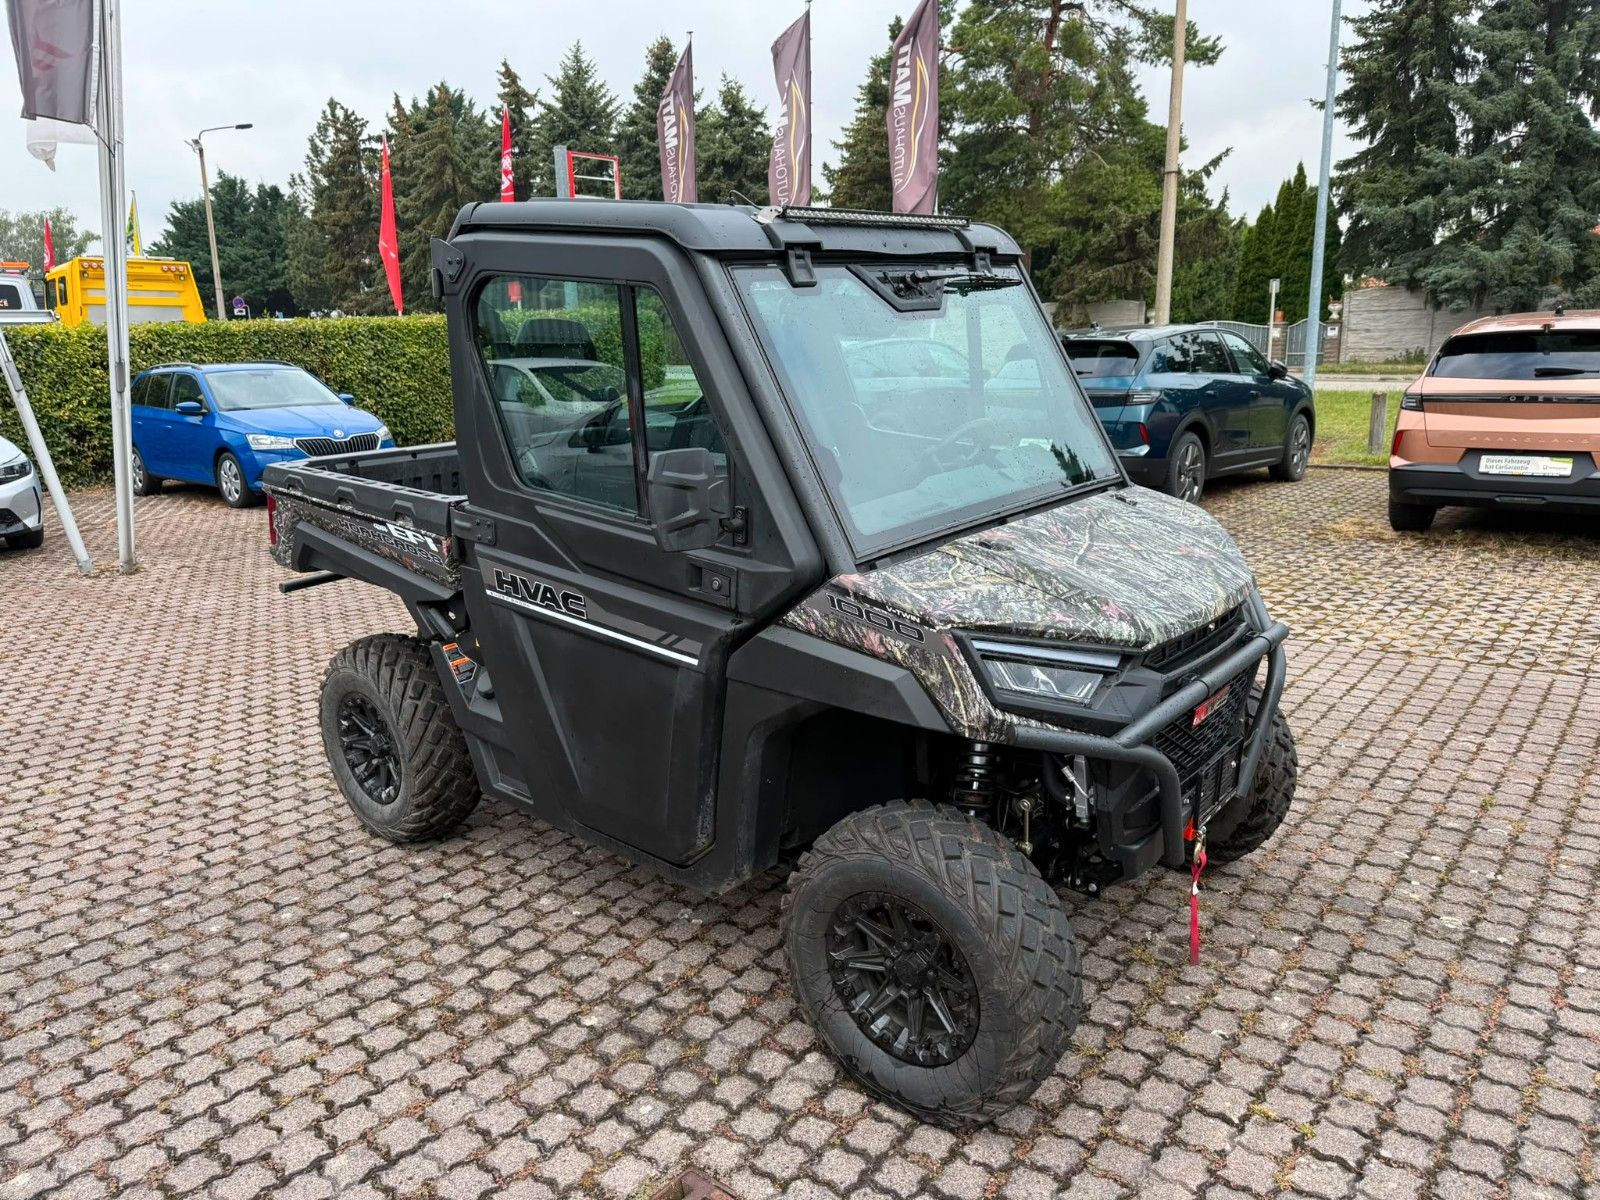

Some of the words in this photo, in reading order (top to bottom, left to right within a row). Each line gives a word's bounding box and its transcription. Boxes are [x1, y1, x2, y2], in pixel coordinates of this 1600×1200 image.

[1504, 459, 1531, 467] Fahrzeug
[494, 568, 587, 620] HVAC
[825, 592, 925, 643] 1000
[886, 605, 920, 623] V-TWIN
